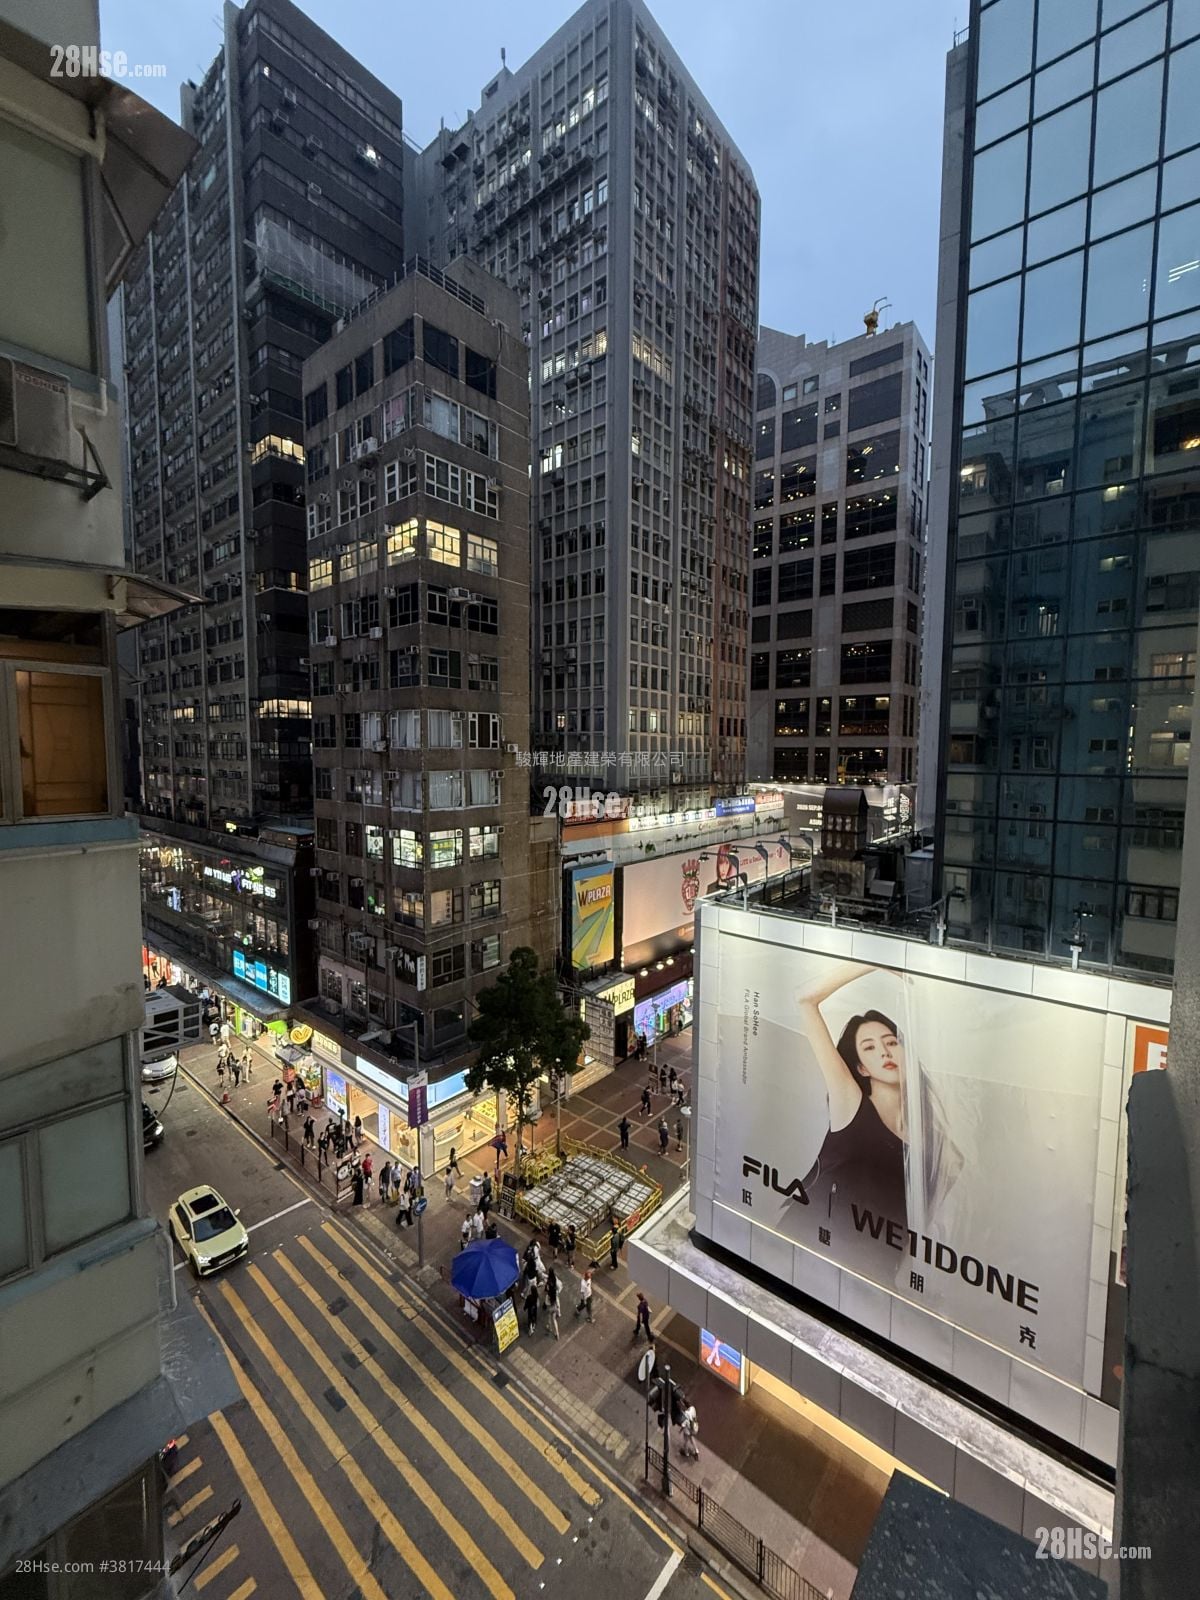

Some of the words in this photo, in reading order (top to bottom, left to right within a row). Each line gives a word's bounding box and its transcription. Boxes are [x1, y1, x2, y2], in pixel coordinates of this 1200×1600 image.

[16, 373, 65, 394] TOSHIBA
[743, 1155, 810, 1206] FILA
[850, 1203, 1040, 1316] WE11DONE
